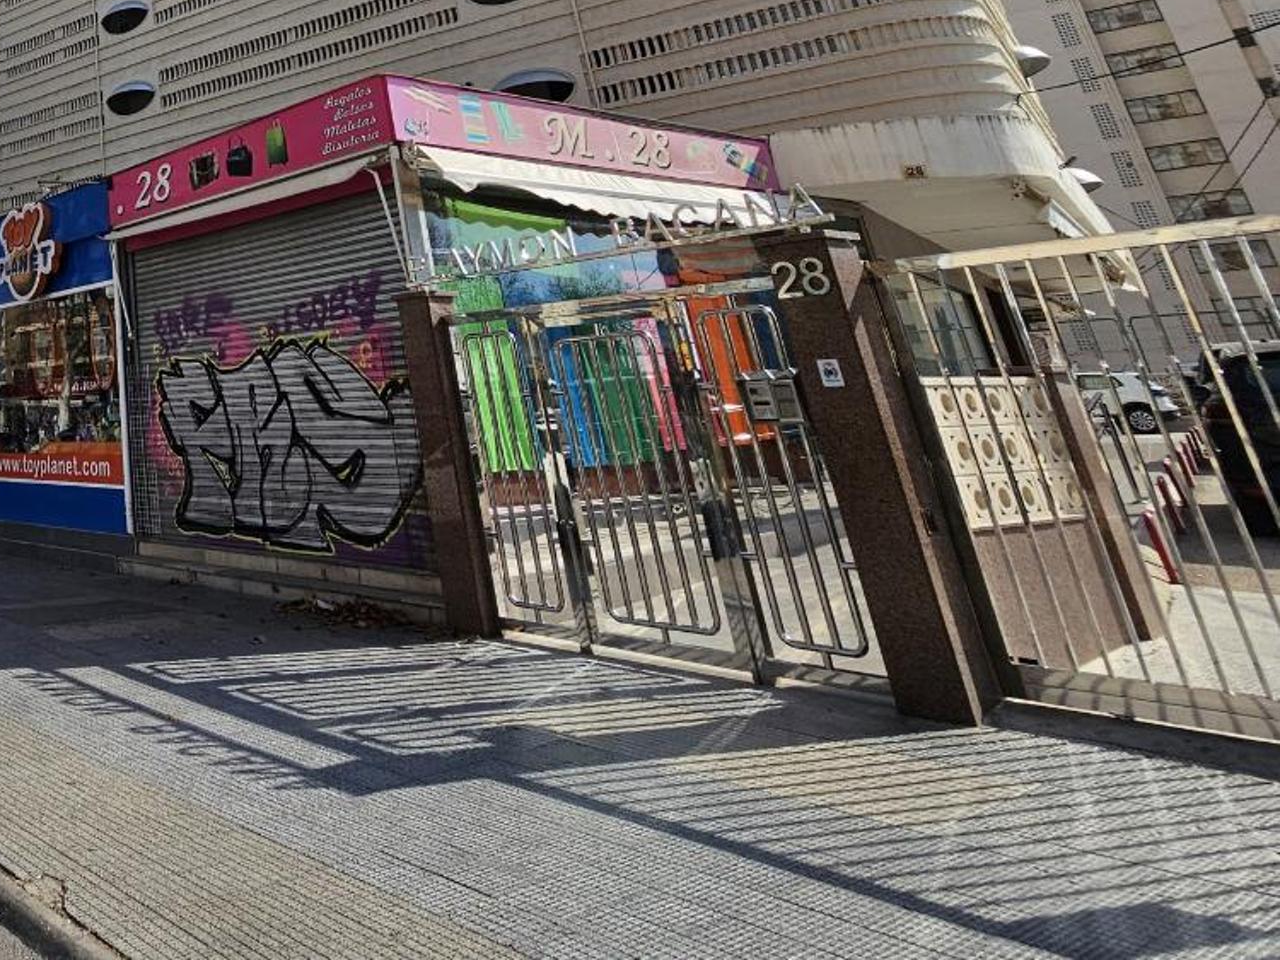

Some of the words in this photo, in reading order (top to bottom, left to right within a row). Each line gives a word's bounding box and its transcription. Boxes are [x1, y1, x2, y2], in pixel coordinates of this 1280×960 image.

[629, 130, 671, 168] 28
[134, 162, 171, 210] 28
[770, 257, 831, 300] 28
